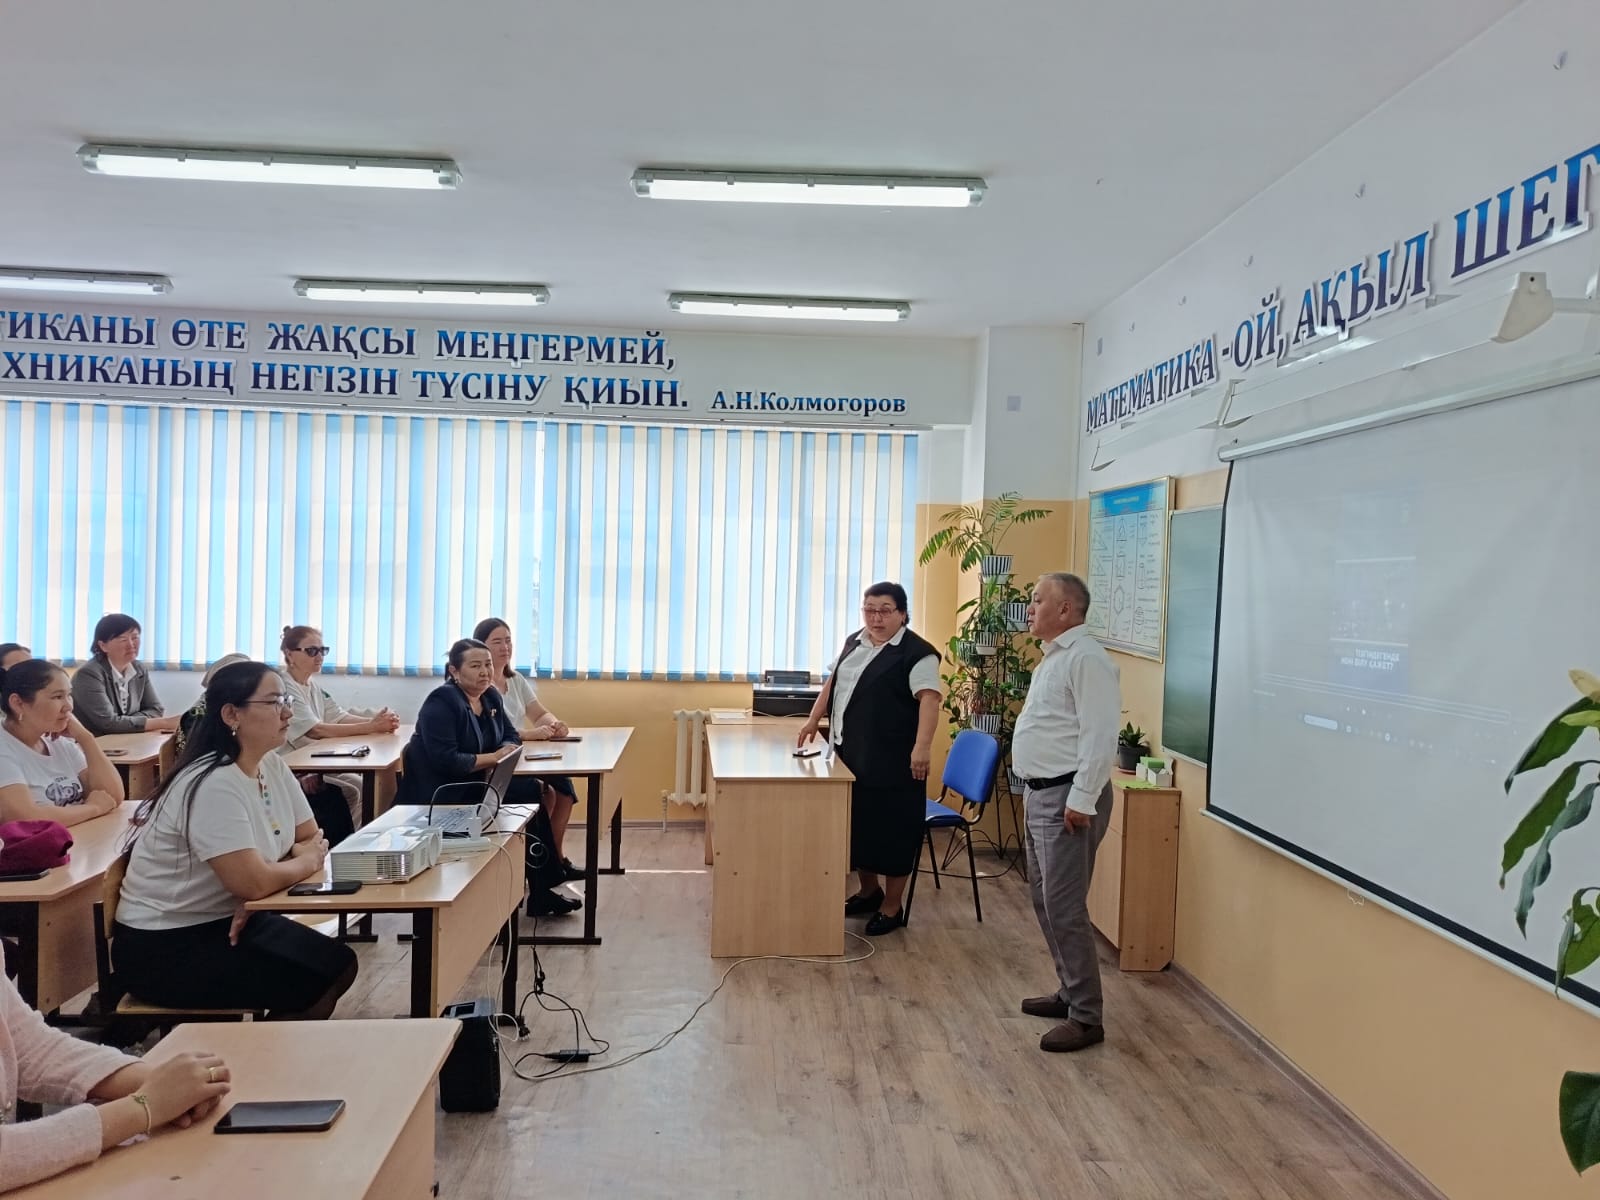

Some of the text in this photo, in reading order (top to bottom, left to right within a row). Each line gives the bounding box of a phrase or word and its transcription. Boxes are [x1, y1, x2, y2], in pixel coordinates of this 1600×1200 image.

[172, 319, 246, 349] ӨТЕ
[268, 323, 415, 359] ЖАҚСЫ
[436, 329, 674, 370] МЕҢГЕРМЕЙ,
[1086, 339, 1215, 433] МАТЕМАТИКА
[1292, 230, 1429, 344] АҚЫЛ
[2, 352, 688, 408] ХНИКАНЫҢ НЕГІЗІН ТҮСІНУ ҚИЫН.
